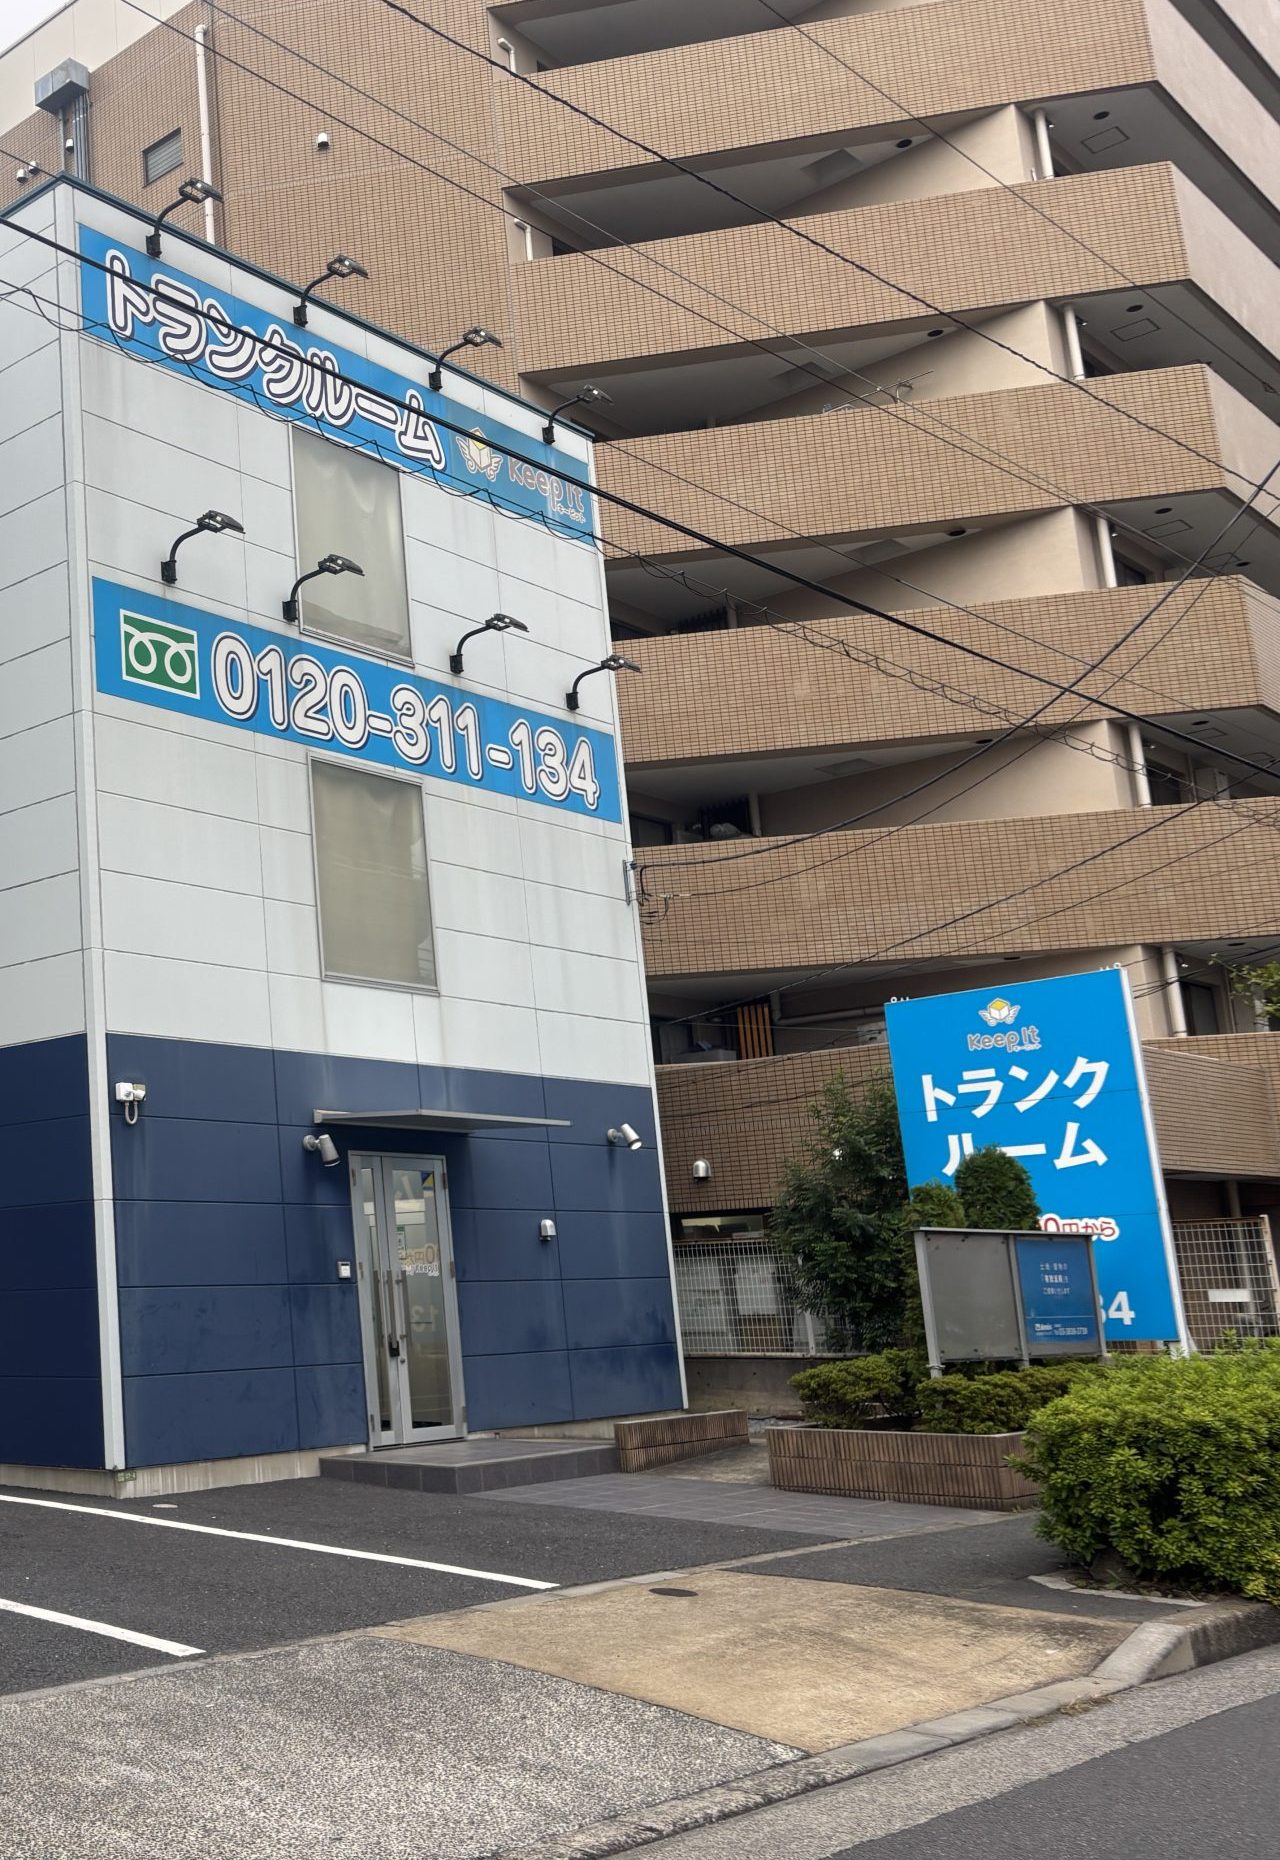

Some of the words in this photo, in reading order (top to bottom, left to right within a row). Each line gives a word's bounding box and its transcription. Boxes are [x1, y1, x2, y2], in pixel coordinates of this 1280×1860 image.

[104, 248, 447, 471] トランクルーム
[211, 631, 600, 810] 0120-311-134
[967, 1030, 1020, 1053] Keep
[922, 1056, 1110, 1122] トランク
[942, 1121, 1109, 1177] ルーム
